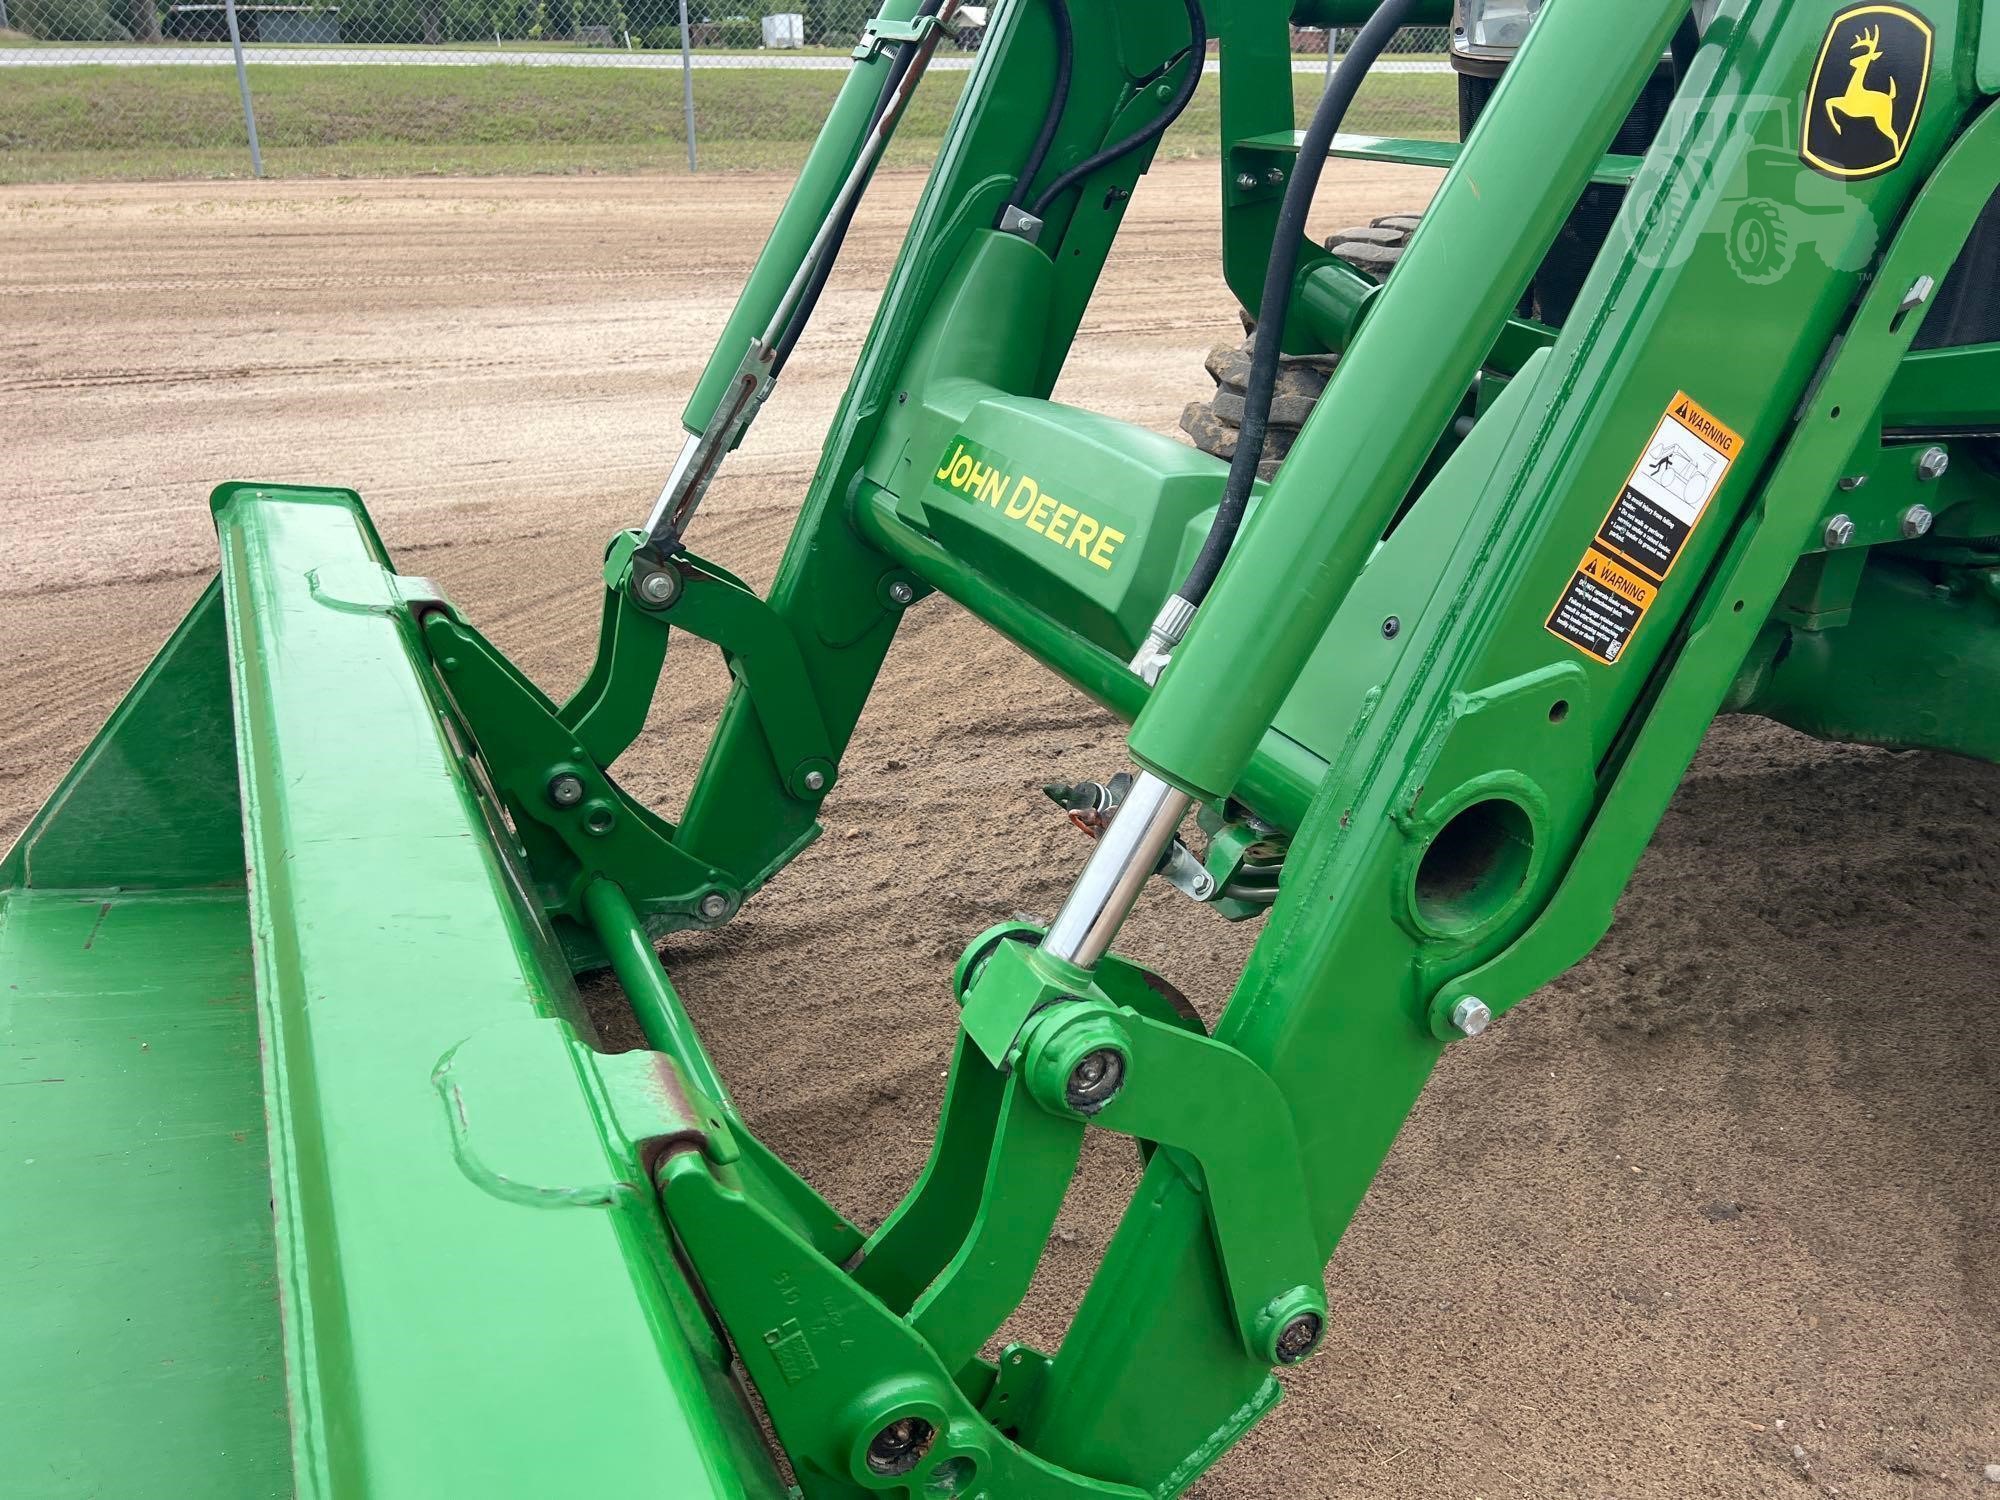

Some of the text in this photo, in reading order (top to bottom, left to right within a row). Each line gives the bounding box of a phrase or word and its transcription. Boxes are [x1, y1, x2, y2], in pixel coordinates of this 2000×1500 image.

[1688, 410, 1733, 450] WARNING
[937, 444, 1126, 570] JOHN DEERE
[1600, 566, 1646, 602] WARNING
